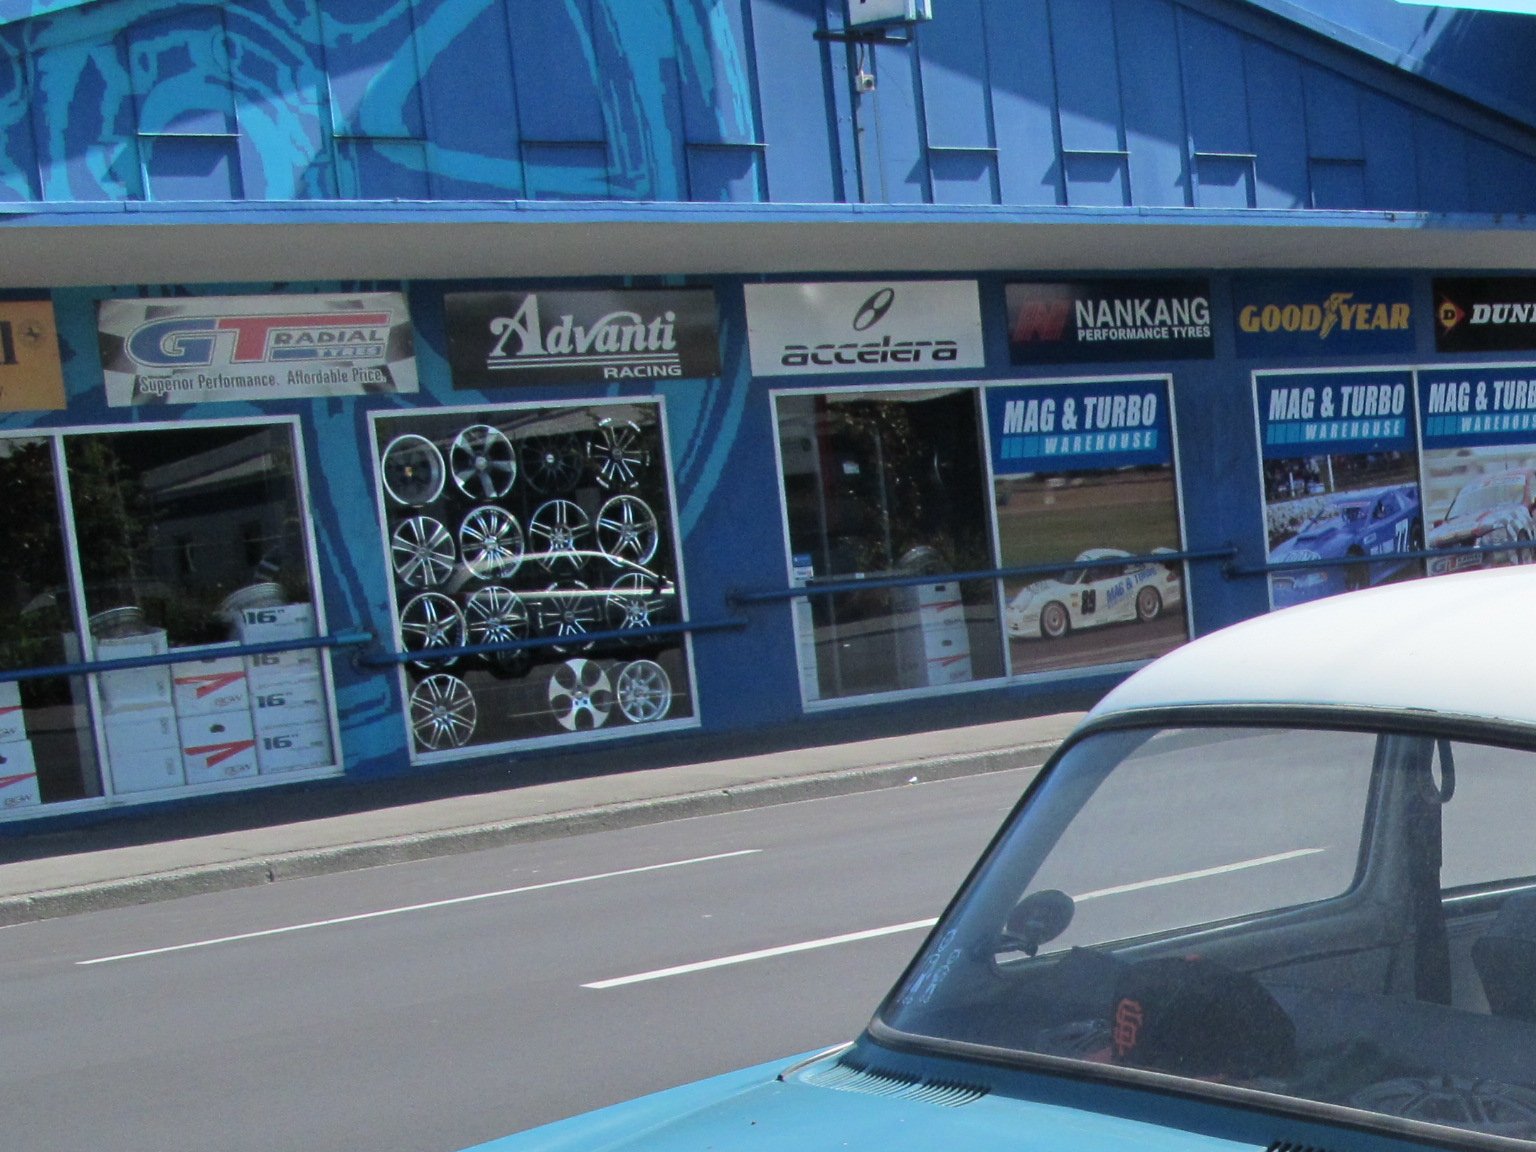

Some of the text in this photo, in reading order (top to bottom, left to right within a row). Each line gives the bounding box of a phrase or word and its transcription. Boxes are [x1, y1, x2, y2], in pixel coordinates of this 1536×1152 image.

[488, 293, 678, 357] Advanti
[1075, 297, 1210, 328] NANKANG
[273, 328, 386, 346] RADIAL
[1077, 326, 1211, 341] PERFORMANCE TYRES
[780, 335, 959, 367] accelera
[140, 374, 194, 396] Superior
[199, 371, 280, 390] Performance.
[287, 368, 349, 386] Affordable
[602, 364, 683, 380] RACING
[1269, 383, 1406, 420] MAG & TURBO
[1428, 382, 1471, 413] MAG
[1475, 381, 1489, 411] &
[1003, 393, 1158, 435] MAG & TURBO
[1044, 431, 1152, 455] WAREHOUSE
[1304, 419, 1402, 440] WAREHOUSE
